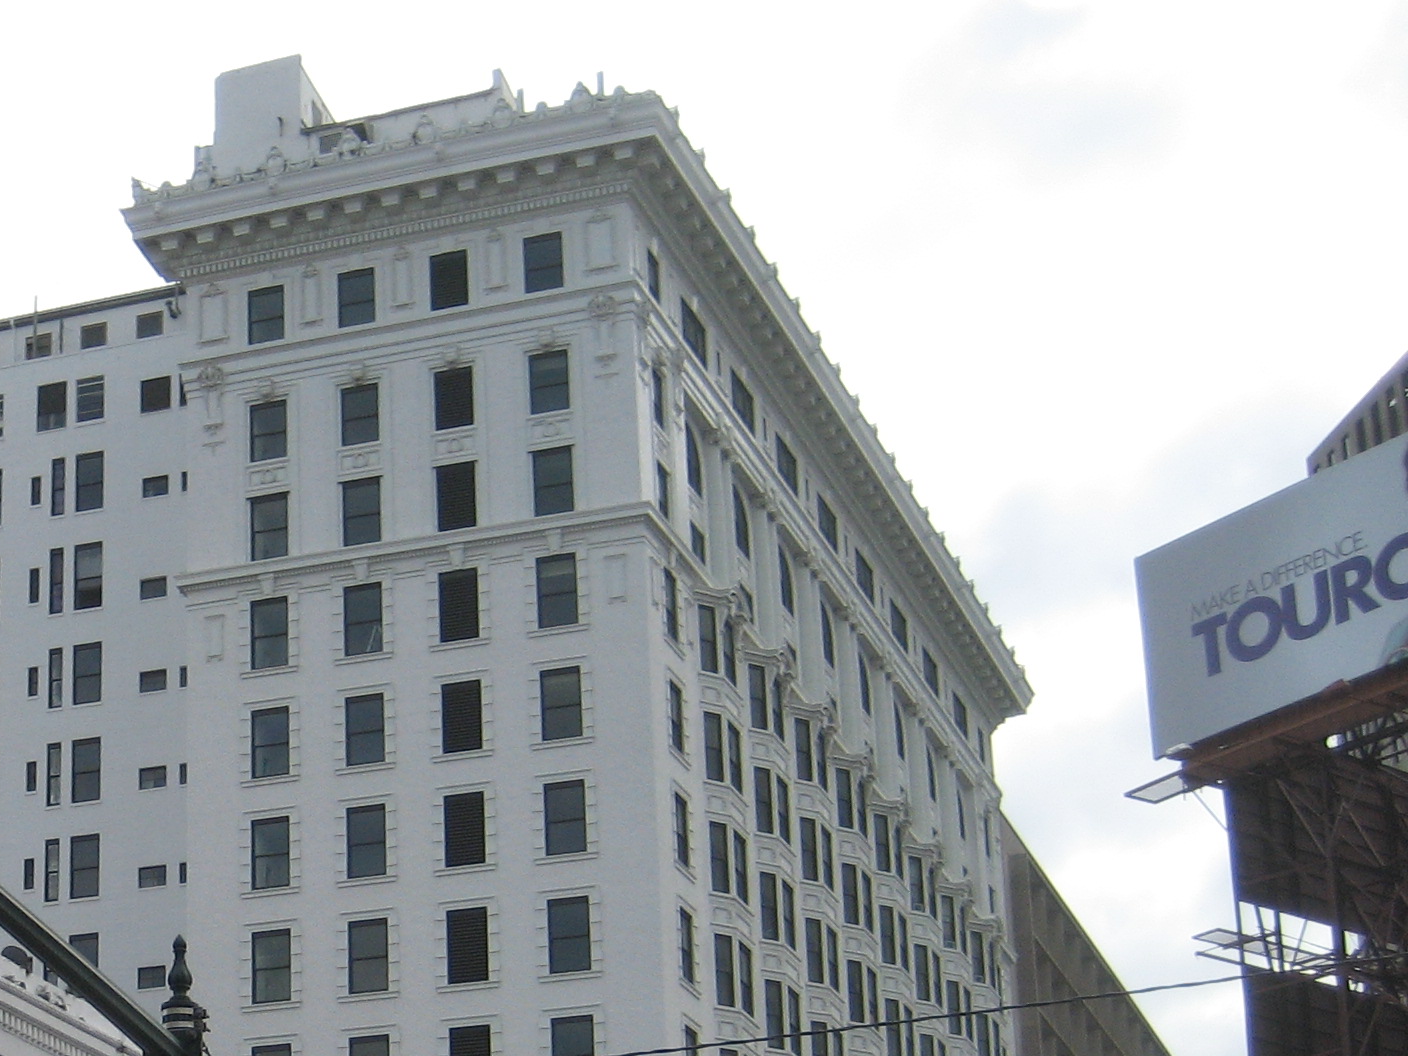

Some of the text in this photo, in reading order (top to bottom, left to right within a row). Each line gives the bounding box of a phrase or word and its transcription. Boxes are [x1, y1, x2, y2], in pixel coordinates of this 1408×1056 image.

[1193, 531, 1368, 617] MAKE A DIFFERENCE
